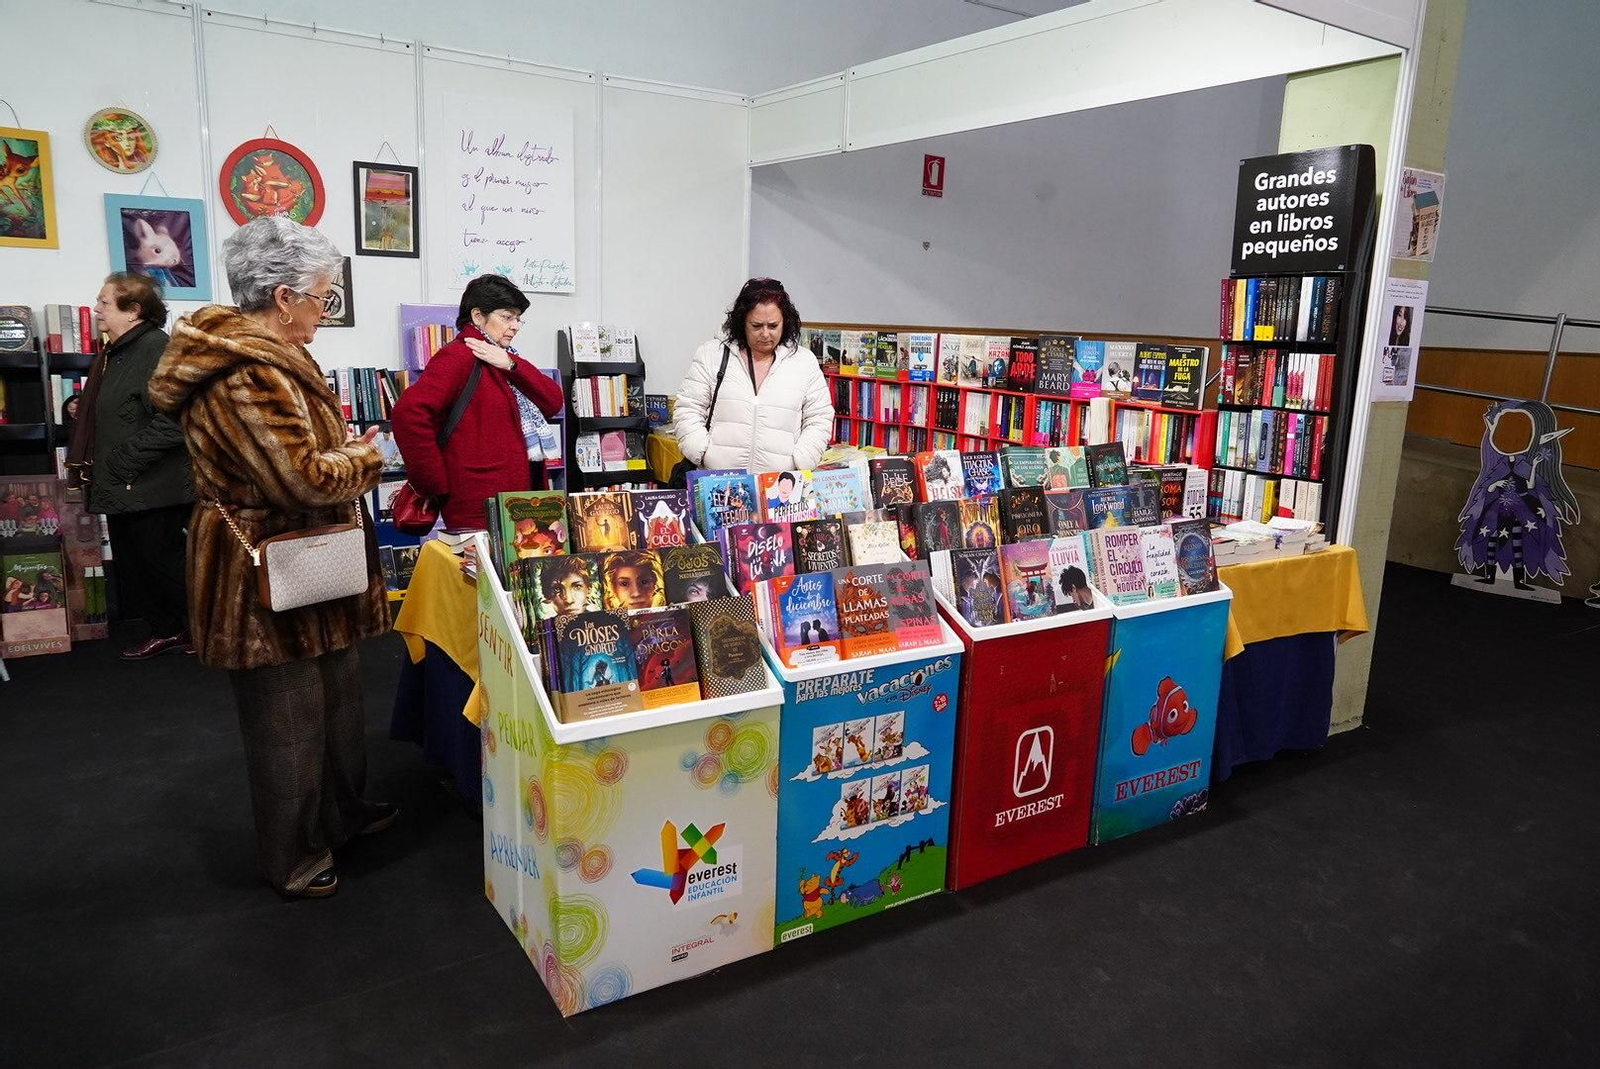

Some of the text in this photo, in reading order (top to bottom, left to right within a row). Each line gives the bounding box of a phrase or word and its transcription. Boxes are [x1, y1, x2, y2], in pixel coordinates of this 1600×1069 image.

[1254, 166, 1337, 191] Grandes
[1256, 191, 1330, 212] autores
[1249, 212, 1334, 234] en libros
[1241, 233, 1339, 260] pequeños
[1015, 351, 1034, 363] TODO
[1168, 358, 1199, 367] MAESTRO
[1010, 361, 1037, 379] ARDE
[1041, 372, 1069, 382] MARY
[1174, 372, 1191, 380] FUGA
[1038, 380, 1070, 391] BEARD
[968, 466, 992, 477] CHASE
[774, 500, 810, 518] PERFECTOS
[1161, 497, 1177, 506] SOY
[1161, 510, 1173, 518] YO
[1189, 506, 1202, 519] 55
[660, 527, 672, 535] EL
[1018, 523, 1041, 535] ORO
[652, 533, 680, 548] CICLO
[1105, 533, 1139, 548] ROMPER
[677, 554, 709, 570] OJOS
[1051, 549, 1080, 567] LLUVIA
[1107, 550, 1118, 562] EL
[792, 577, 823, 597] Antes
[851, 573, 884, 587] CORTE
[858, 588, 869, 597] DE
[786, 596, 832, 614] diciembre
[842, 596, 888, 613] LLAMAS
[844, 611, 890, 625] PLATEADAS
[569, 624, 620, 647] DIOSES
[641, 625, 679, 641] PERLA
[8, 640, 63, 653] EDELVIVES
[478, 611, 514, 678] SENTIR
[589, 641, 618, 656] NORTE
[856, 656, 953, 706] vacaciones
[796, 683, 863, 705] para las mejores
[499, 712, 538, 758] PENSAR
[1114, 760, 1203, 802] EVEREST
[994, 794, 1065, 828] EVEREST
[490, 831, 541, 880] APRENDER
[688, 862, 738, 885] everest
[688, 886, 725, 902] INFANTIL
[782, 924, 813, 942] everest
[671, 937, 715, 956] INTEGRAL
